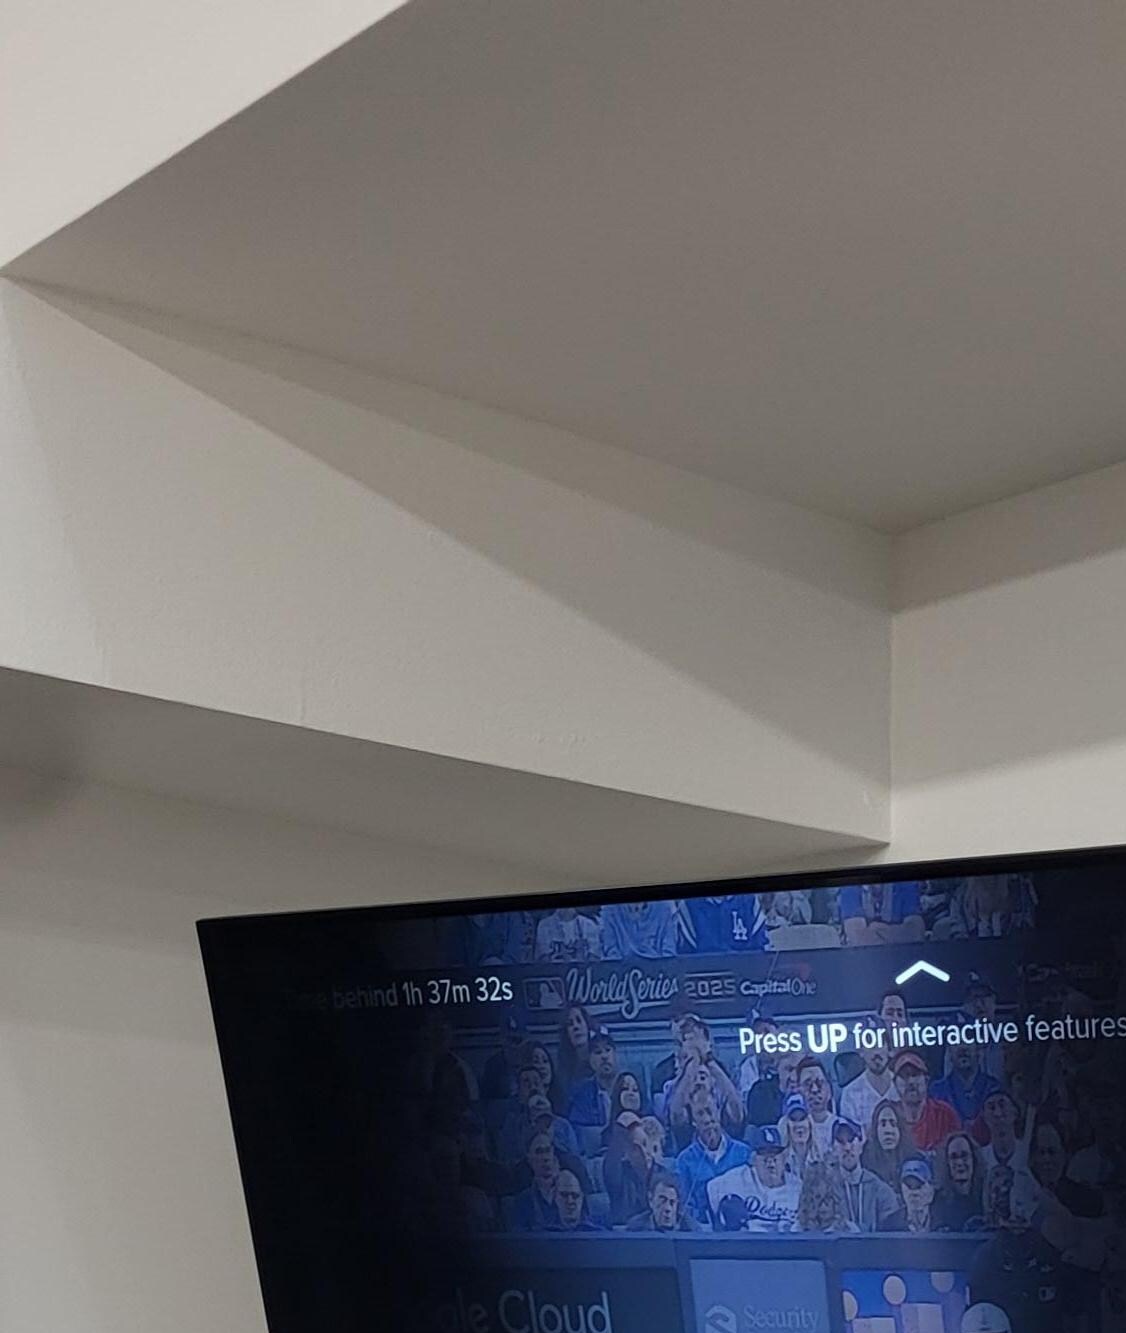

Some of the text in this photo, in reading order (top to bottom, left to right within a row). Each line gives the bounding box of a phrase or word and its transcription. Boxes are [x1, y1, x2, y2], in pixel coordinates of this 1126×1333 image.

[402, 981, 424, 1007] 1h
[426, 979, 471, 1005] 37m
[474, 976, 513, 1002] 32s
[684, 977, 737, 998] 2025
[739, 1027, 803, 1054] Press
[807, 1023, 848, 1053] UP
[852, 1022, 886, 1049] for
[892, 1017, 1019, 1048] interactive
[743, 1303, 820, 1330] Security
